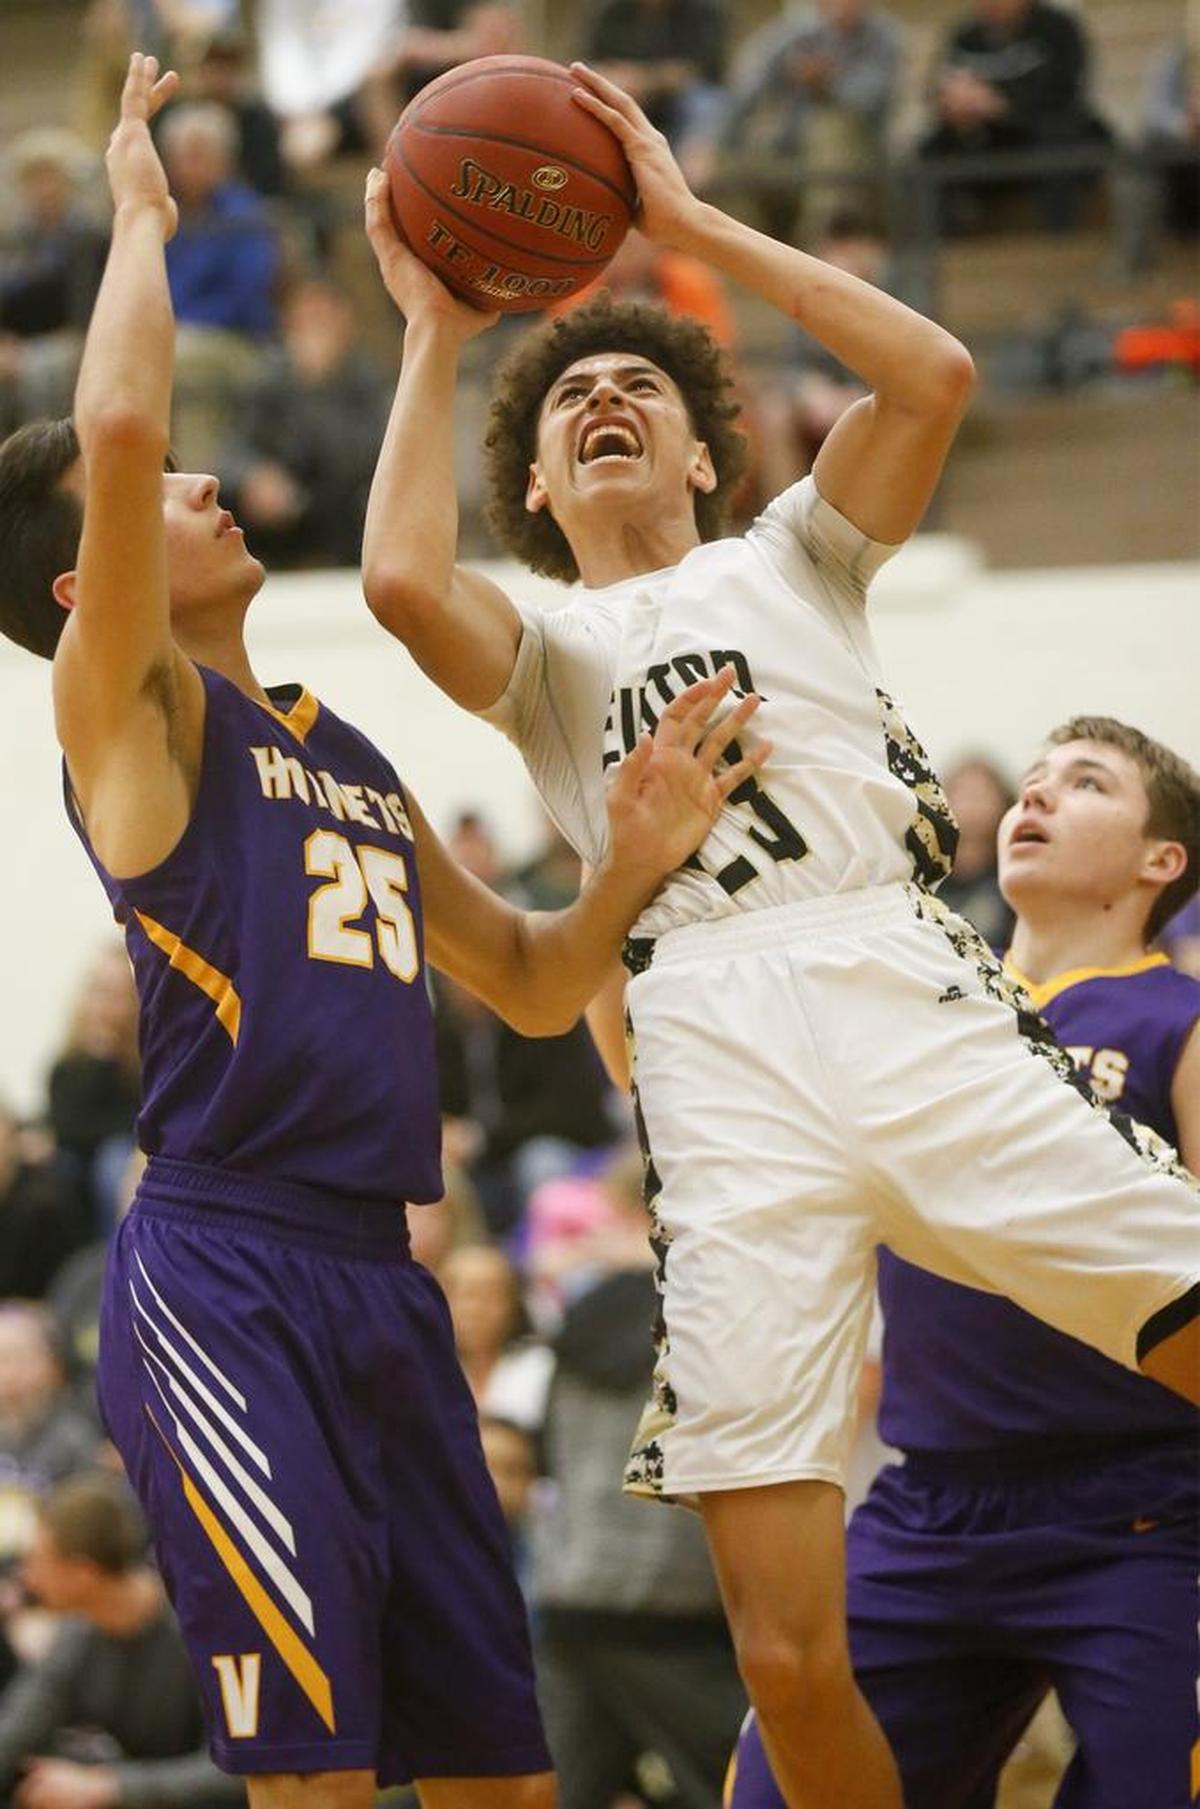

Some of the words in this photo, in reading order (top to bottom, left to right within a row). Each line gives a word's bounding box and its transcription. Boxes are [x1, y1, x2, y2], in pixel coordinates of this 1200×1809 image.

[450, 157, 613, 252] SPALDING
[303, 828, 420, 985] 25
[211, 1653, 261, 1738] V
